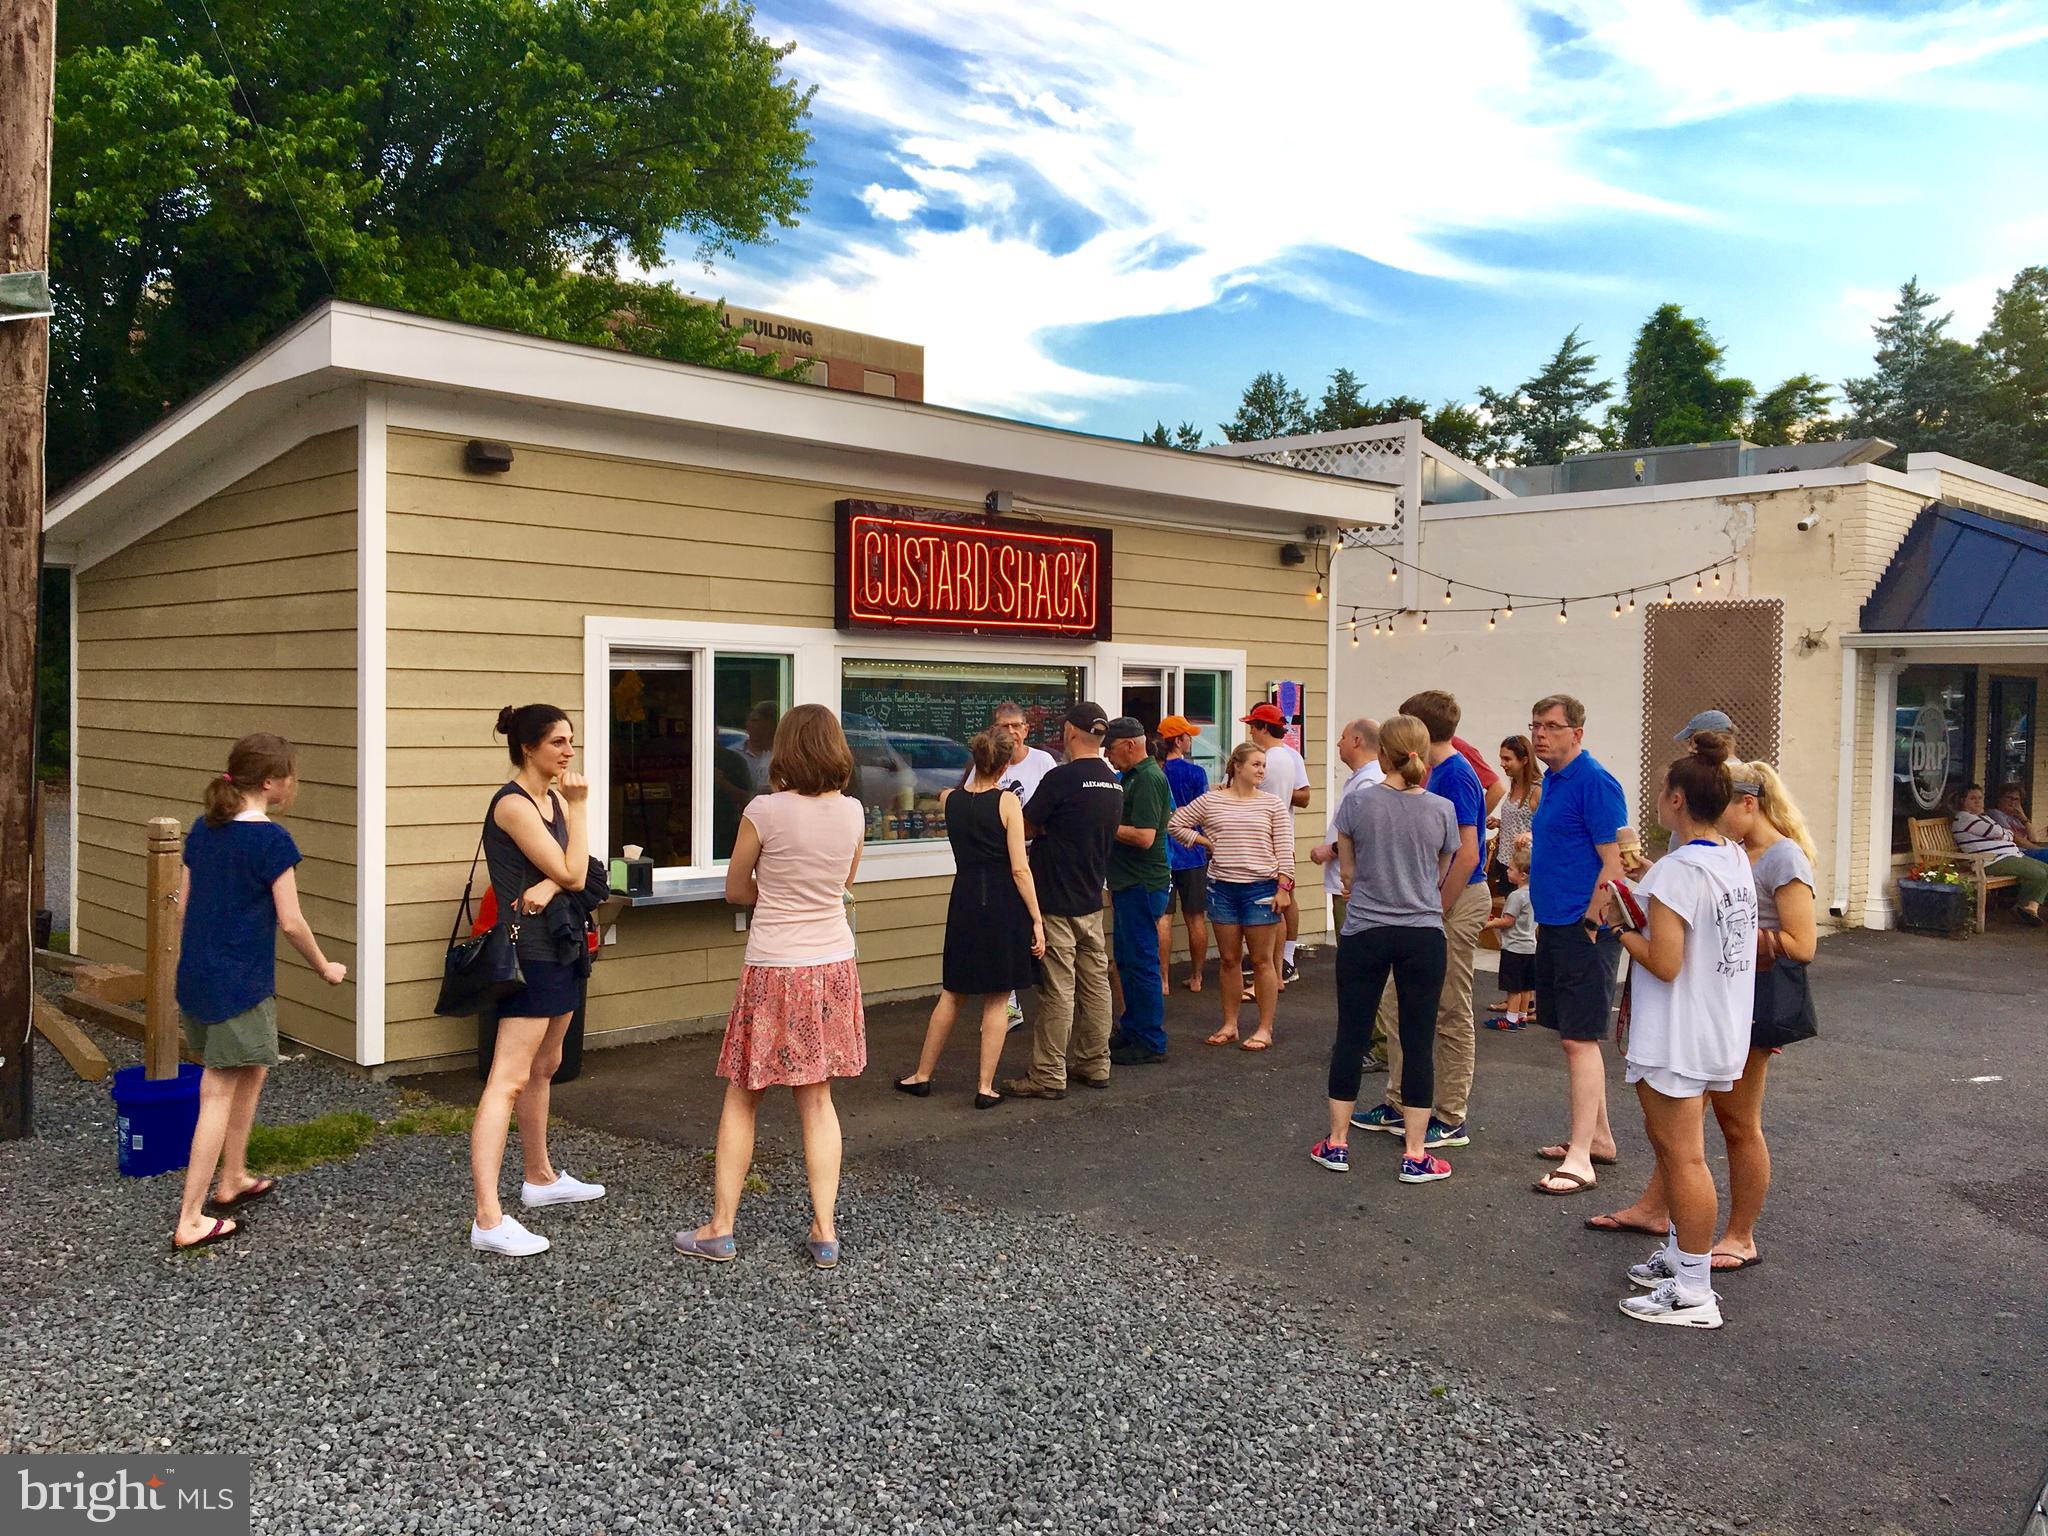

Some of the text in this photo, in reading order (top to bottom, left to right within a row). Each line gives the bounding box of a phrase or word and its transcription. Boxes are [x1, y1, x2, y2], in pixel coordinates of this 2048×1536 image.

[864, 531, 1088, 619] CUSTARD SHACK
[1913, 741, 1947, 771] DRP
